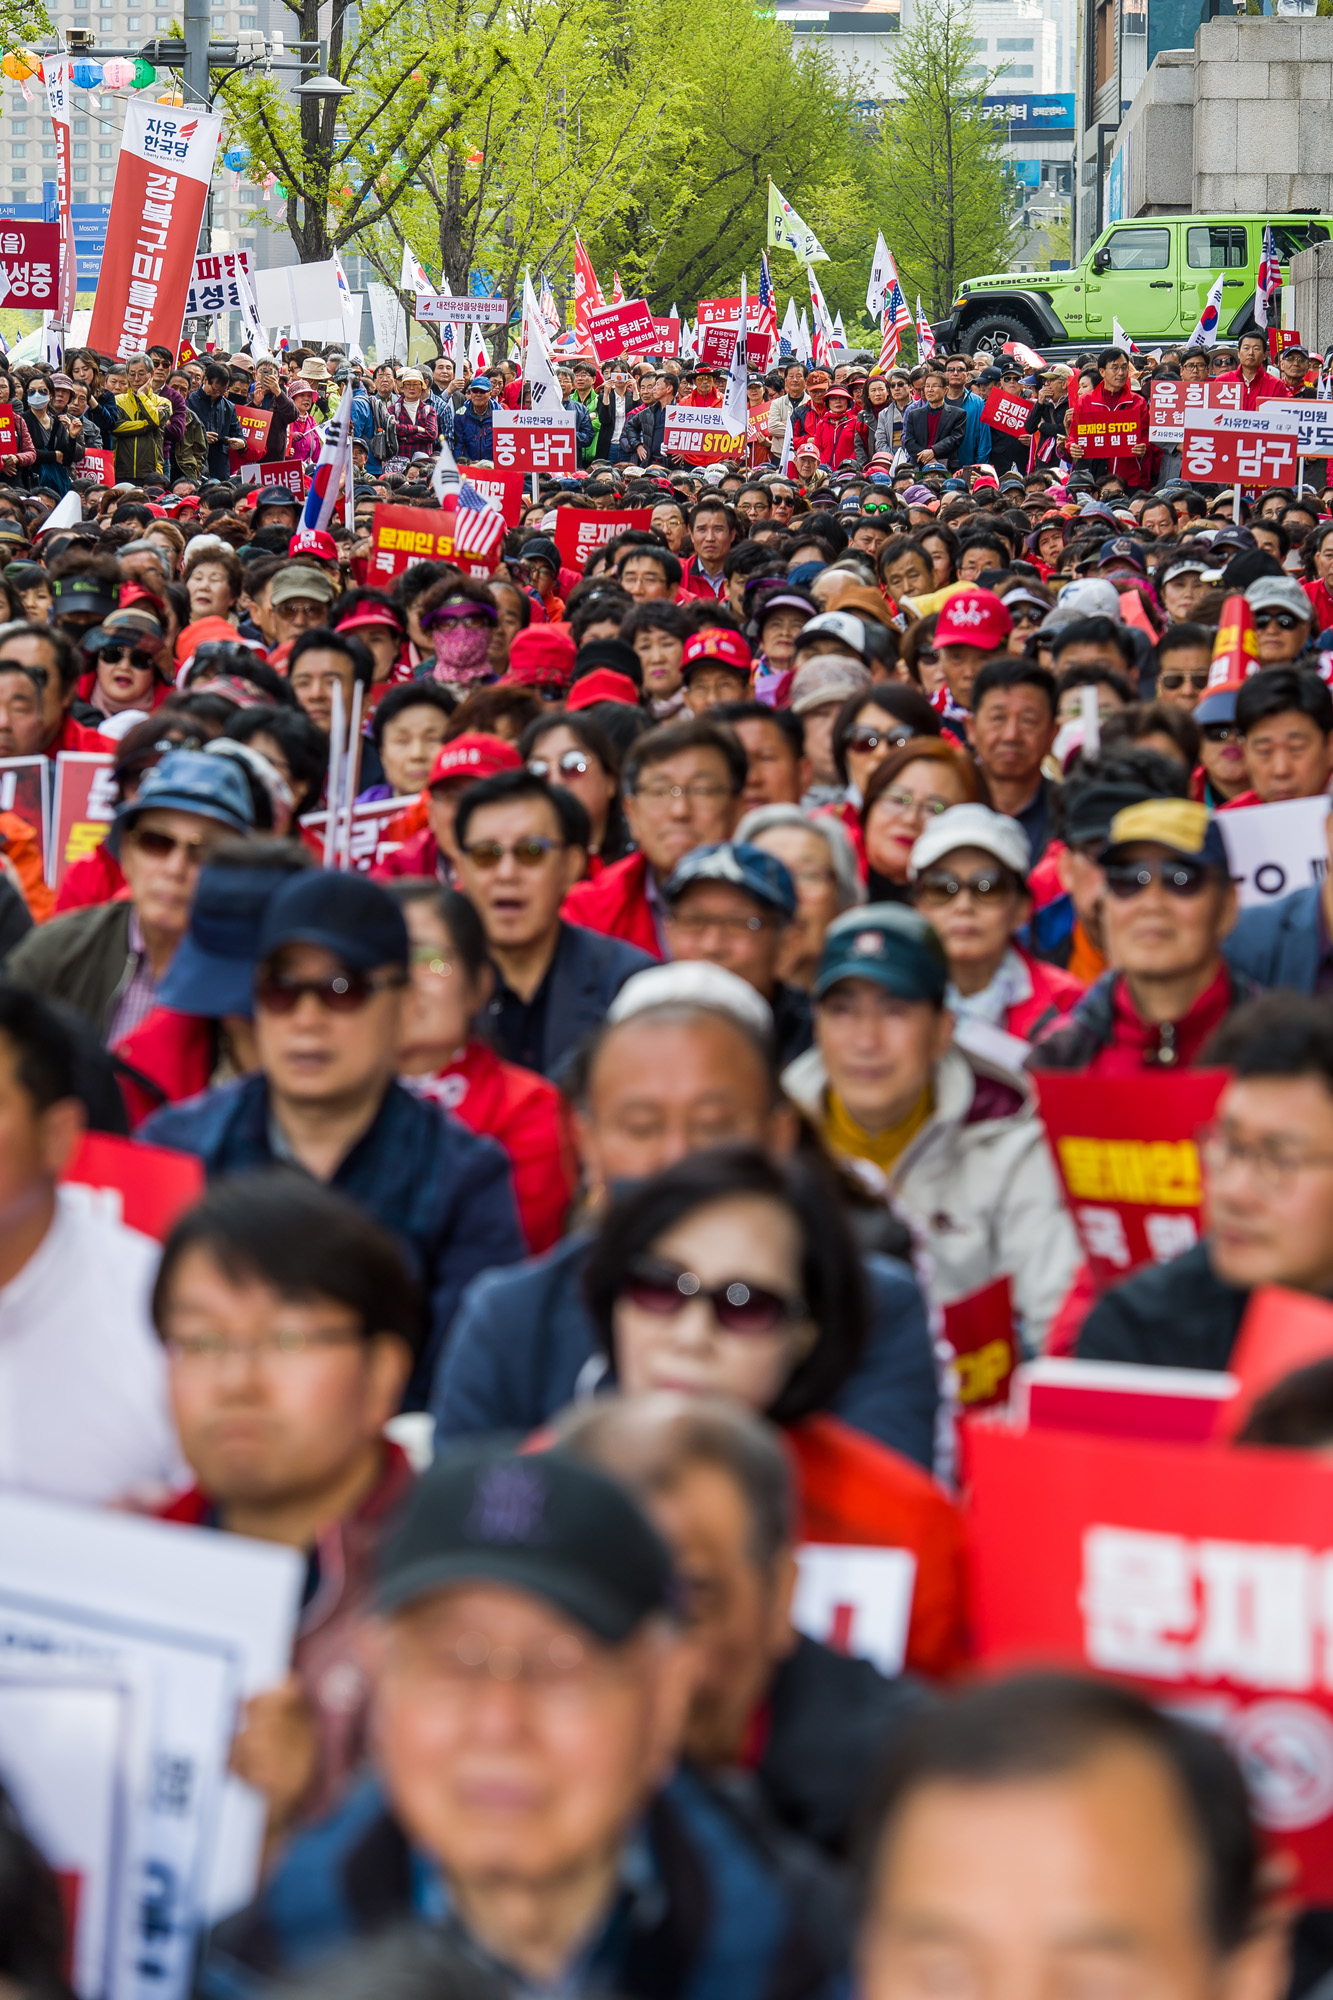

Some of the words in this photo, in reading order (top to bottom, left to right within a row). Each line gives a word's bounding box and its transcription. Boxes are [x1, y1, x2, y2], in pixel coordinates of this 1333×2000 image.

[146, 118, 177, 138] 자유
[144, 135, 189, 158] 한국당
[82, 262, 99, 271] Beijing
[976, 276, 1051, 287] RUBICON
[1064, 313, 1083, 321] Jeep
[594, 327, 617, 344] 부산
[618, 316, 651, 337] 동래구
[998, 399, 1029, 421] 문재인
[242, 417, 267, 429] STOP
[519, 416, 553, 426] 자유한국당
[1077, 424, 1107, 436] 문재인
[1108, 421, 1138, 434] STOP
[1223, 417, 1270, 431] 자유한국당
[667, 430, 704, 452] 문재인
[703, 432, 746, 454] STOP!
[1157, 431, 1184, 439] 자유한국당
[294, 540, 323, 552] SEOUL
[378, 526, 434, 555] 문재인
[1058, 1136, 1201, 1206] 문재인
[1080, 1523, 1333, 1693] 문재
